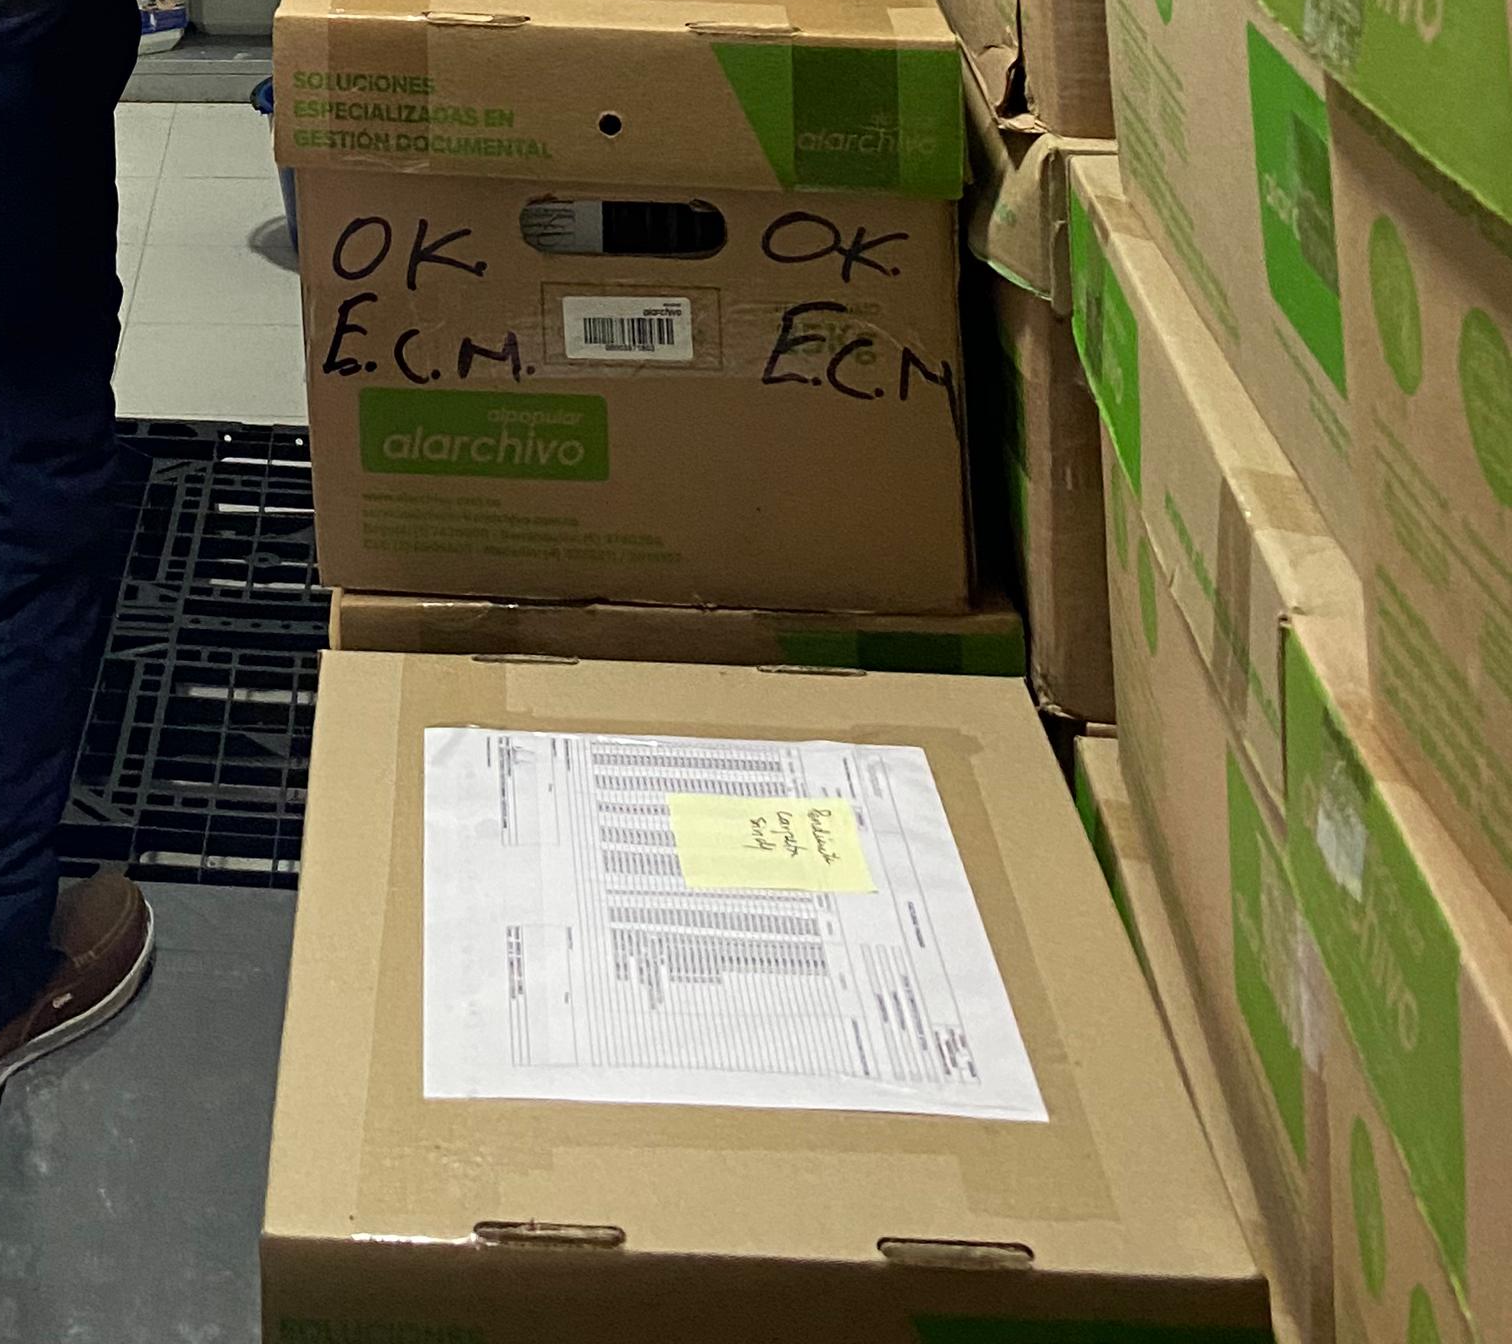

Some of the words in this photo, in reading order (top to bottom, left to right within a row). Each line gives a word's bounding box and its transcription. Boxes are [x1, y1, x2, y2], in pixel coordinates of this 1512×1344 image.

[293, 71, 435, 95] SOLUCIONES
[293, 100, 478, 127] ESPECIALIZADAS
[484, 109, 514, 128] EN
[293, 126, 390, 152] GESTIÓN
[395, 134, 553, 159] DOCUMENTAL
[489, 408, 585, 427] alpopular
[383, 425, 585, 466] alarchivo
